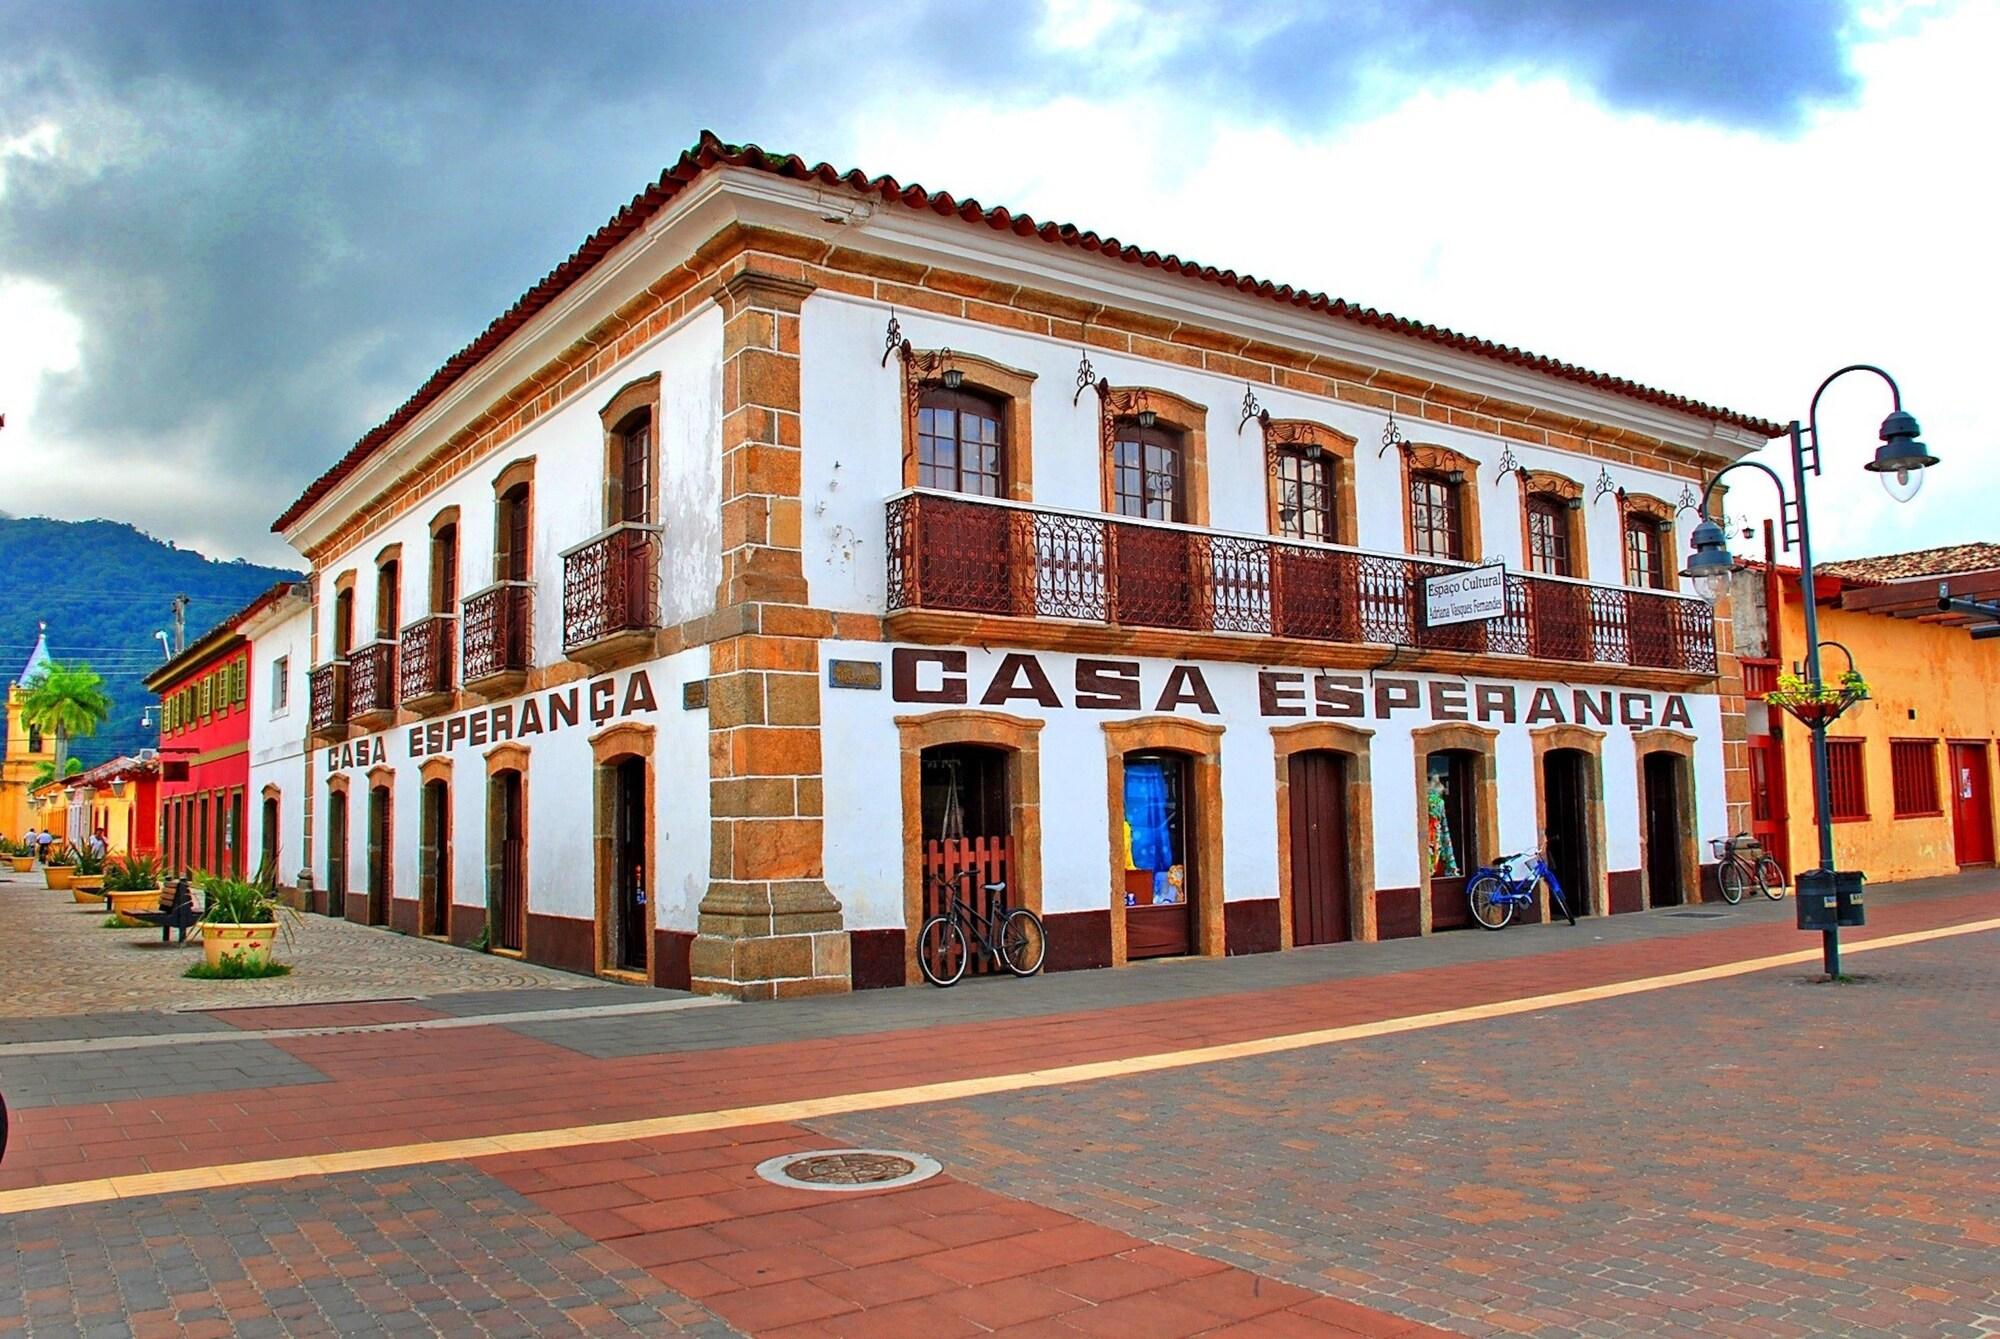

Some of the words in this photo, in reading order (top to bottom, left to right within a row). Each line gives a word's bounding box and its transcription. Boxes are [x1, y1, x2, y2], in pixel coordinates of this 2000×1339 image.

[1428, 584, 1460, 598] Espaço
[1462, 572, 1501, 591] Cultural
[328, 736, 387, 772] CASA
[409, 669, 658, 757] ESPERANÇA
[892, 648, 1221, 714] CASA
[1258, 671, 1693, 731] ESPERANÇA
